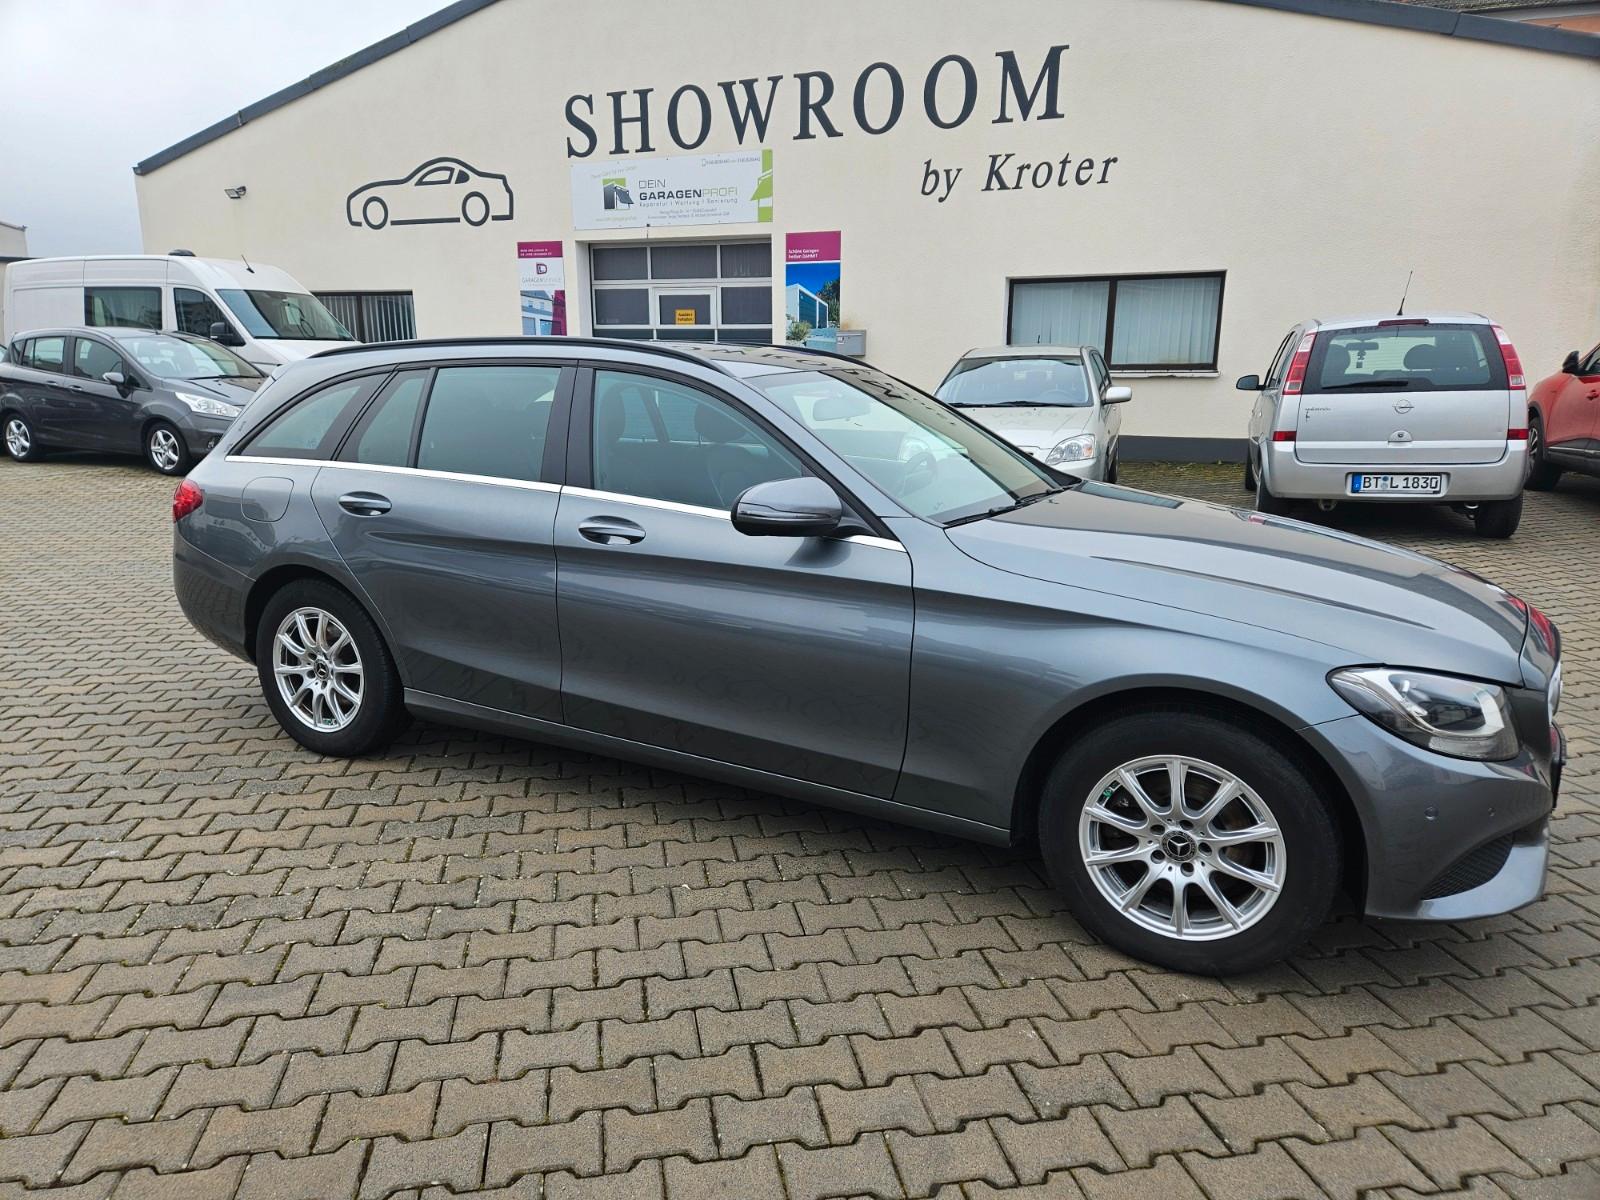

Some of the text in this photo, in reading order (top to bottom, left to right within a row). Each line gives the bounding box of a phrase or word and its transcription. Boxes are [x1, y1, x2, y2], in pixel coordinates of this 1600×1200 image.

[565, 45, 1070, 159] SHOWROOM
[639, 179, 666, 189] DEIN
[921, 152, 1119, 203] by Kroter
[640, 186, 738, 201] GARAGENPROFI
[1363, 476, 1438, 489] BT L 1830
